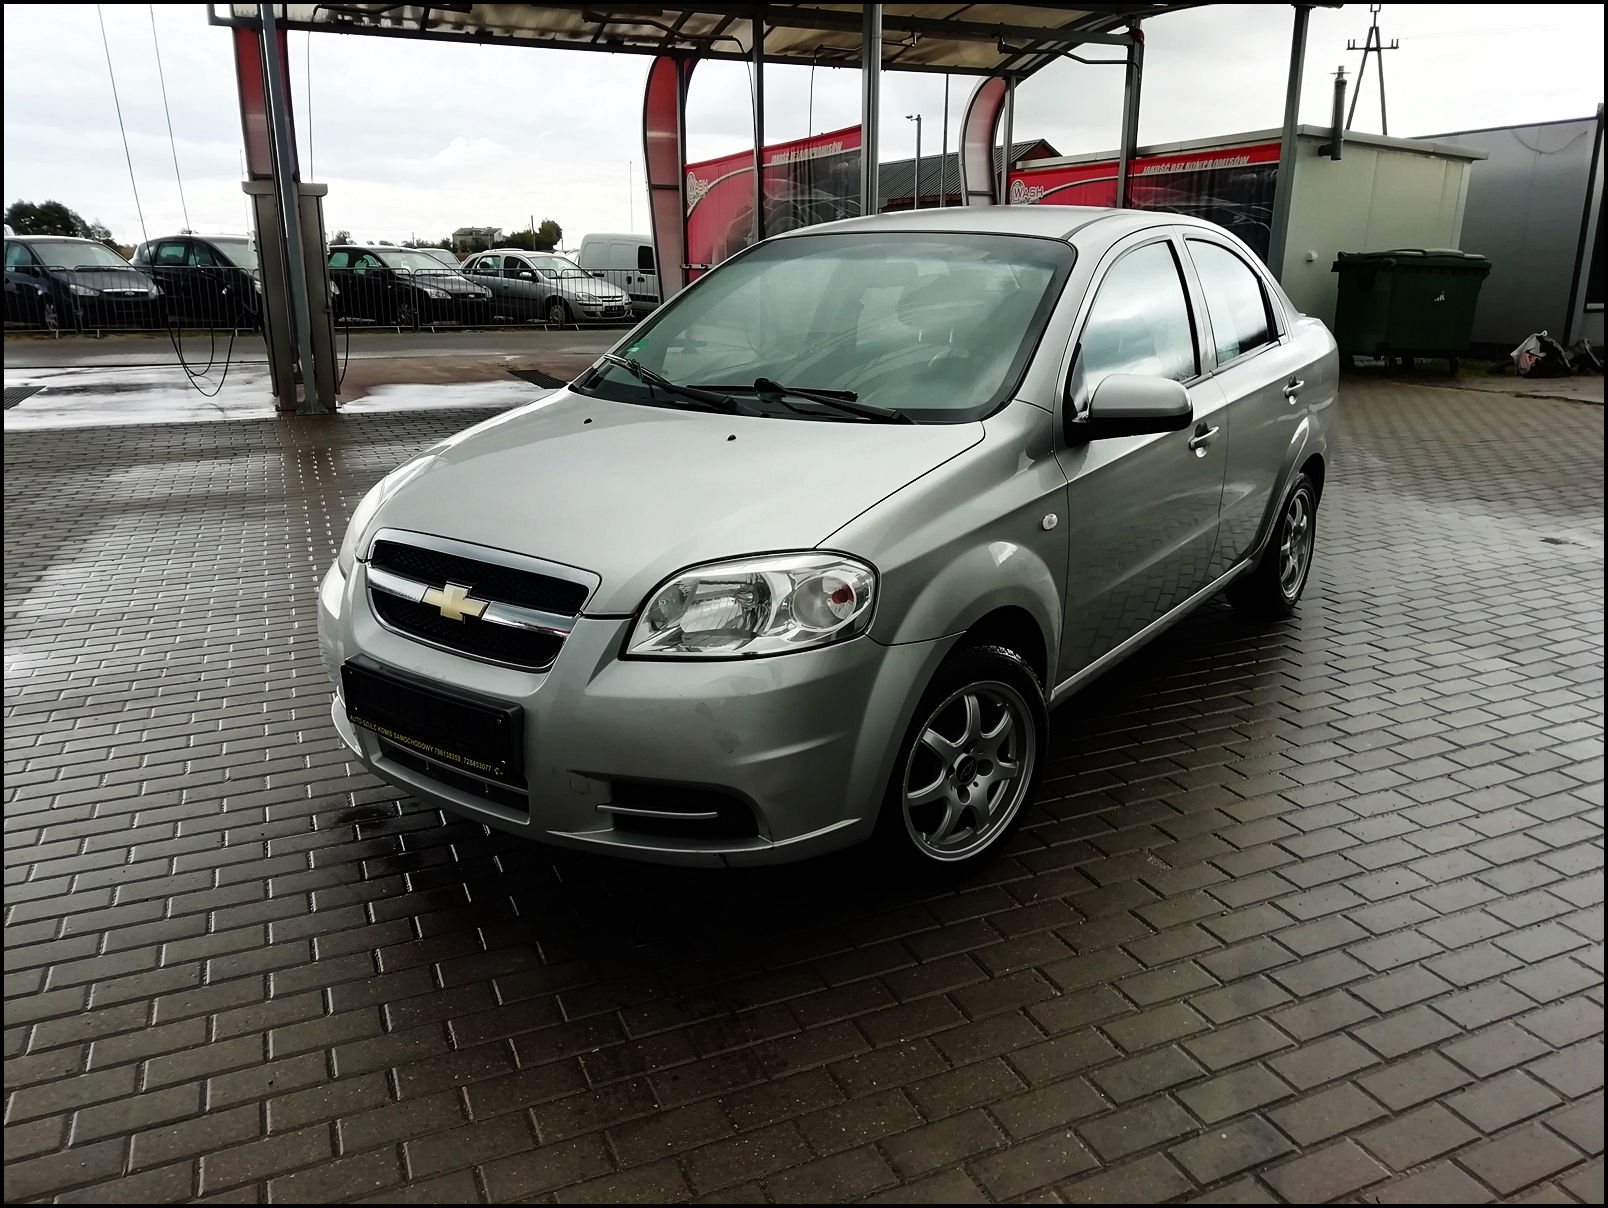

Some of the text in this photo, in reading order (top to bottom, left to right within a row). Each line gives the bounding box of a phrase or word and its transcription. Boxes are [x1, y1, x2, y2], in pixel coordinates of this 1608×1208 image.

[1170, 162, 1185, 172] BEZ
[1185, 155, 1250, 170] KOMPROMISÓW
[1013, 186, 1044, 198] WASH
[393, 732, 434, 753] SAMOCHODOWY
